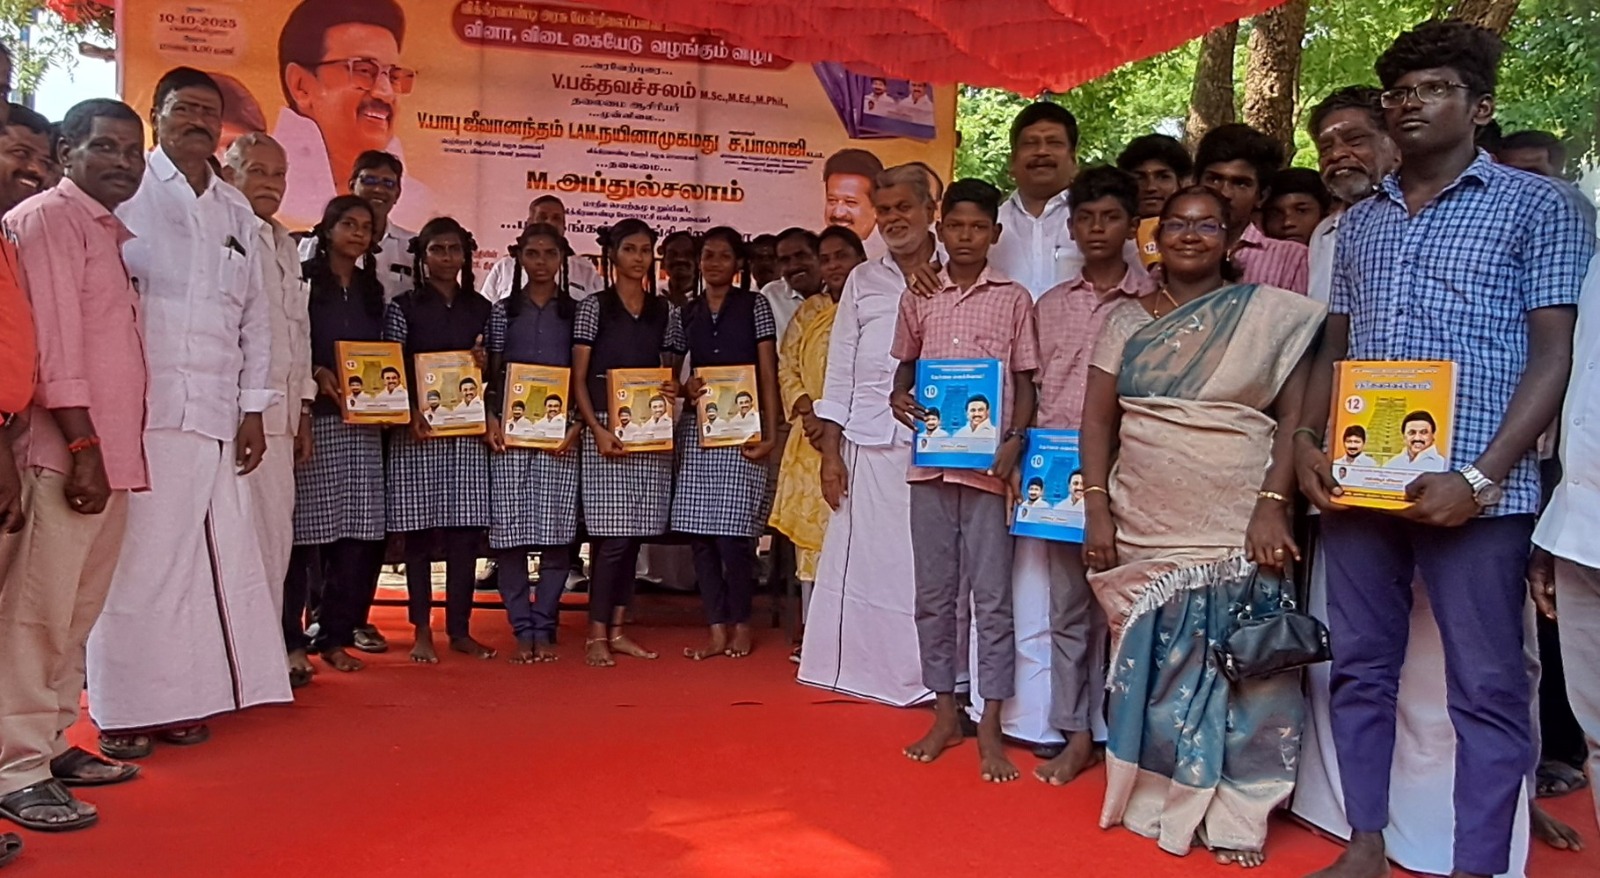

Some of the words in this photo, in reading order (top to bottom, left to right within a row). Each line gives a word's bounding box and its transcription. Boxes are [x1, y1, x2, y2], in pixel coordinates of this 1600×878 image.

[160, 13, 237, 28] 10-10-2025
[464, 20, 517, 43] வினா,
[521, 26, 569, 46] விடை
[574, 31, 643, 54] கையேடு
[651, 37, 729, 60] வழங்கும்
[552, 72, 697, 99] V.பக்தவச்சலம்
[463, 110, 563, 141] ஜீவானந்தம்
[526, 170, 745, 203] M.அப்துல்சலாம்
[1145, 243, 1156, 252] 12
[926, 387, 936, 396] 10
[1347, 399, 1360, 410] 12
[1032, 456, 1042, 466] 10
